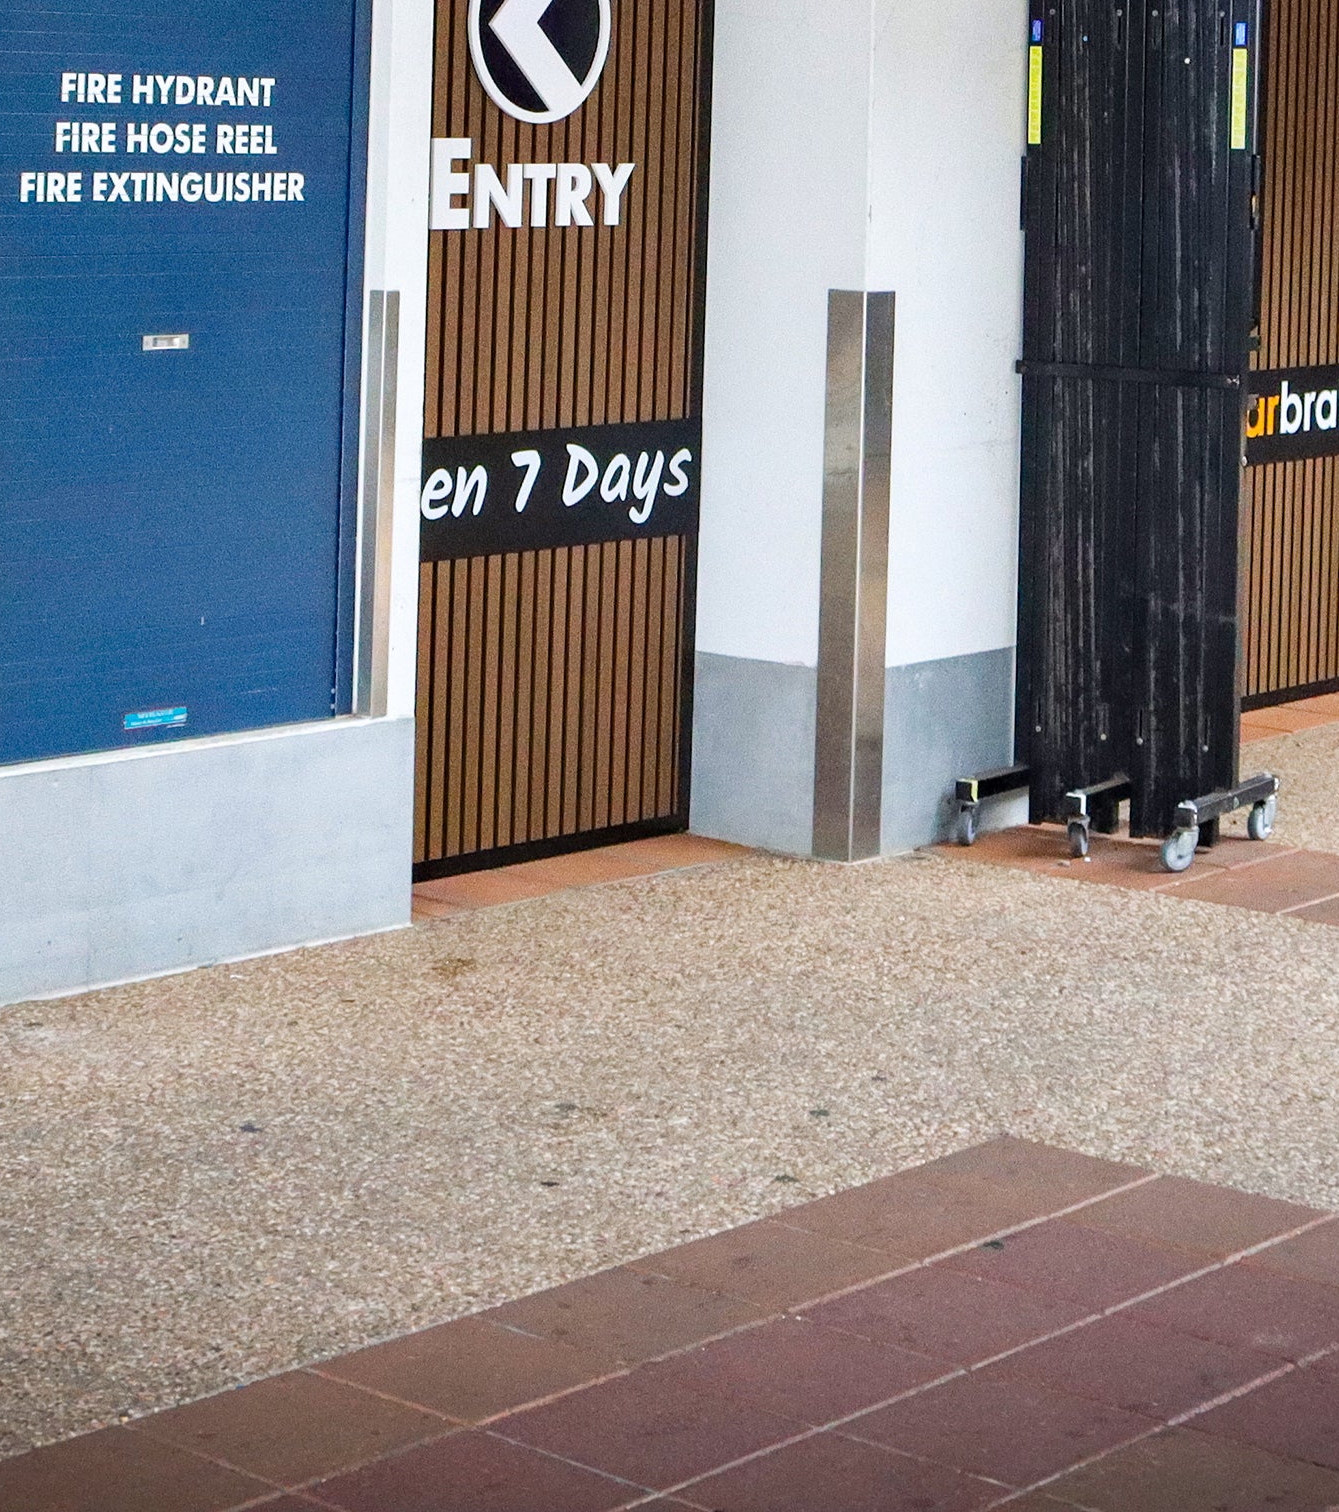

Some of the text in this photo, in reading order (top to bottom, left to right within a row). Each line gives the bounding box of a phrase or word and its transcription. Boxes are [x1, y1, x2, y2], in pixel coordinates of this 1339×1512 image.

[61, 73, 275, 106] FIRE HYDRANT
[55, 122, 278, 154] FIRE HOSE REEL
[19, 172, 305, 202] FIRE EXTINGUISHER
[429, 137, 636, 230] ENTRY
[420, 443, 692, 524] en 7 Days
